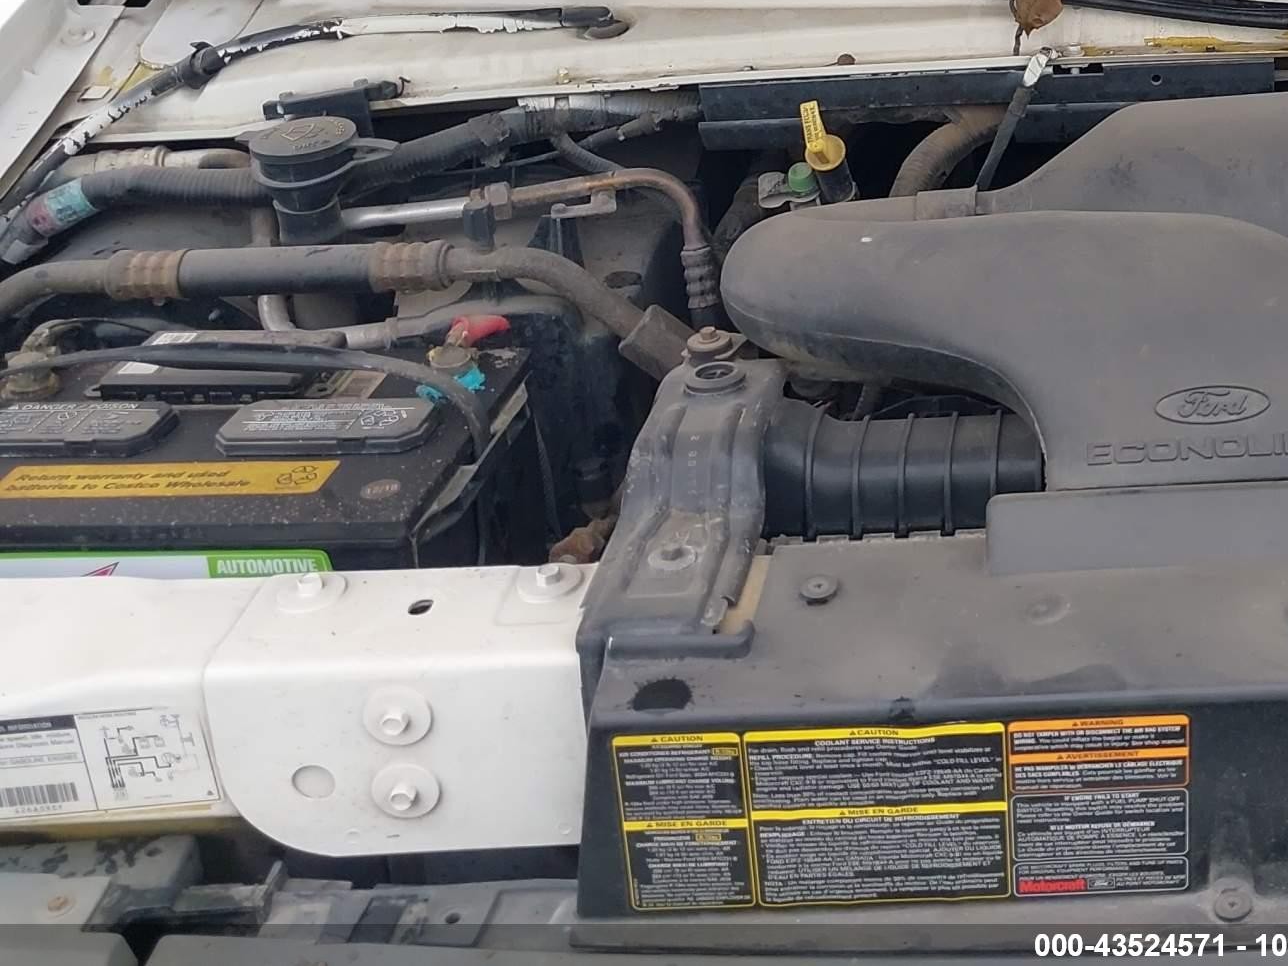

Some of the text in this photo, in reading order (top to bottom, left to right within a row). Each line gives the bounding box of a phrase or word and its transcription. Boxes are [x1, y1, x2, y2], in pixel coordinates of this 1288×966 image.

[1177, 390, 1248, 418] Ford
[16, 470, 229, 482] Return warranty and used
[5, 478, 251, 491] batteries to Costco Wholesale
[216, 559, 318, 574] AUTOMOTIVE
[1079, 719, 1124, 727] WARNING
[856, 729, 899, 737] CAUTION
[660, 735, 703, 743] CAUTION
[1065, 751, 1140, 760] AVERTISSEMENT
[847, 806, 918, 816] MISE EN GARDE
[1019, 879, 1086, 892] Motorcraft
